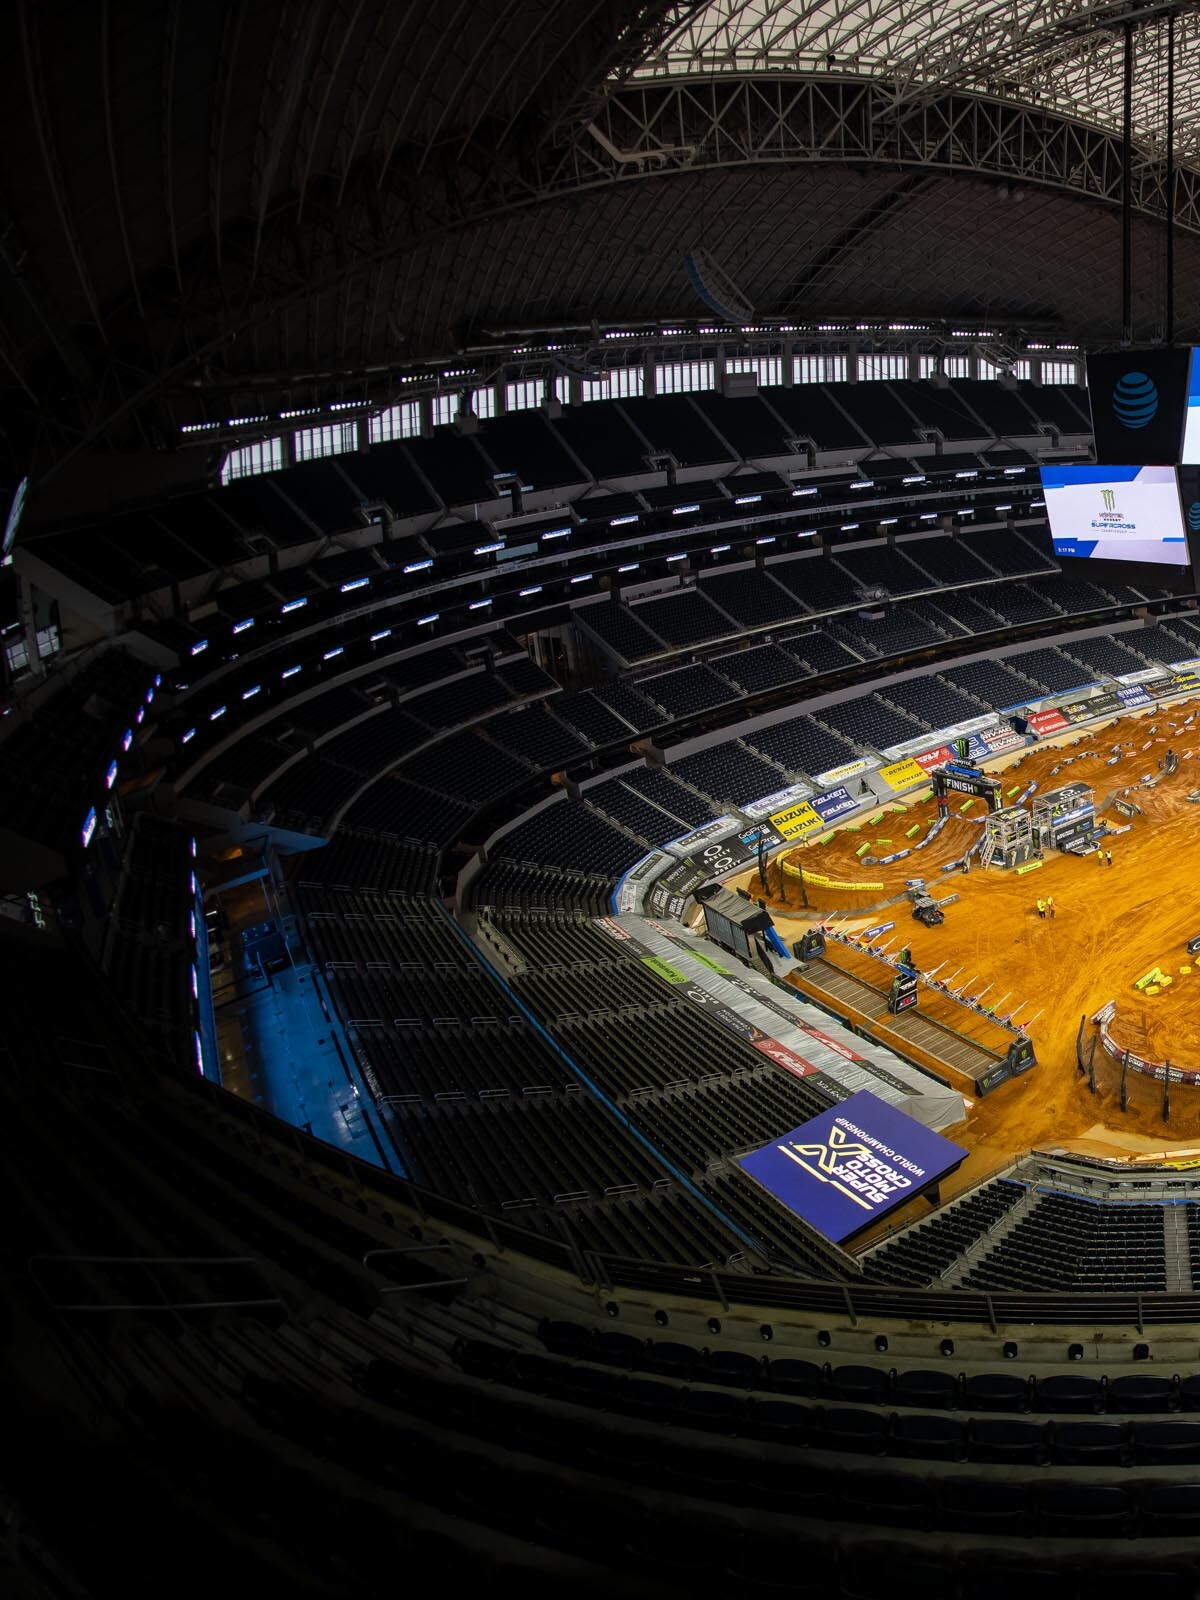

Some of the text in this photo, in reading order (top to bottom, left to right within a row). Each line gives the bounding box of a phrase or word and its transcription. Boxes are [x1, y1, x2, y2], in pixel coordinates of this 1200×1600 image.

[1036, 711, 1060, 722] HONDA
[915, 750, 940, 763] FLY
[888, 761, 915, 776] DUNLOP
[897, 771, 924, 786] DUNLOP
[946, 779, 974, 794] FINISH
[812, 788, 846, 808] FALKEN
[774, 805, 812, 826] SUZUKI
[821, 799, 855, 818] FALKEN
[737, 823, 767, 839] GoPro
[783, 815, 822, 837] SUZUKI
[704, 848, 731, 864] OAKLEY
[714, 859, 741, 876] OAKLEY
[835, 1117, 926, 1178] WORLD CHAMPIONSHIP
[846, 1159, 899, 1195] MOTO
[856, 1152, 912, 1189] CROSS
[832, 1164, 889, 1204] SUPER
